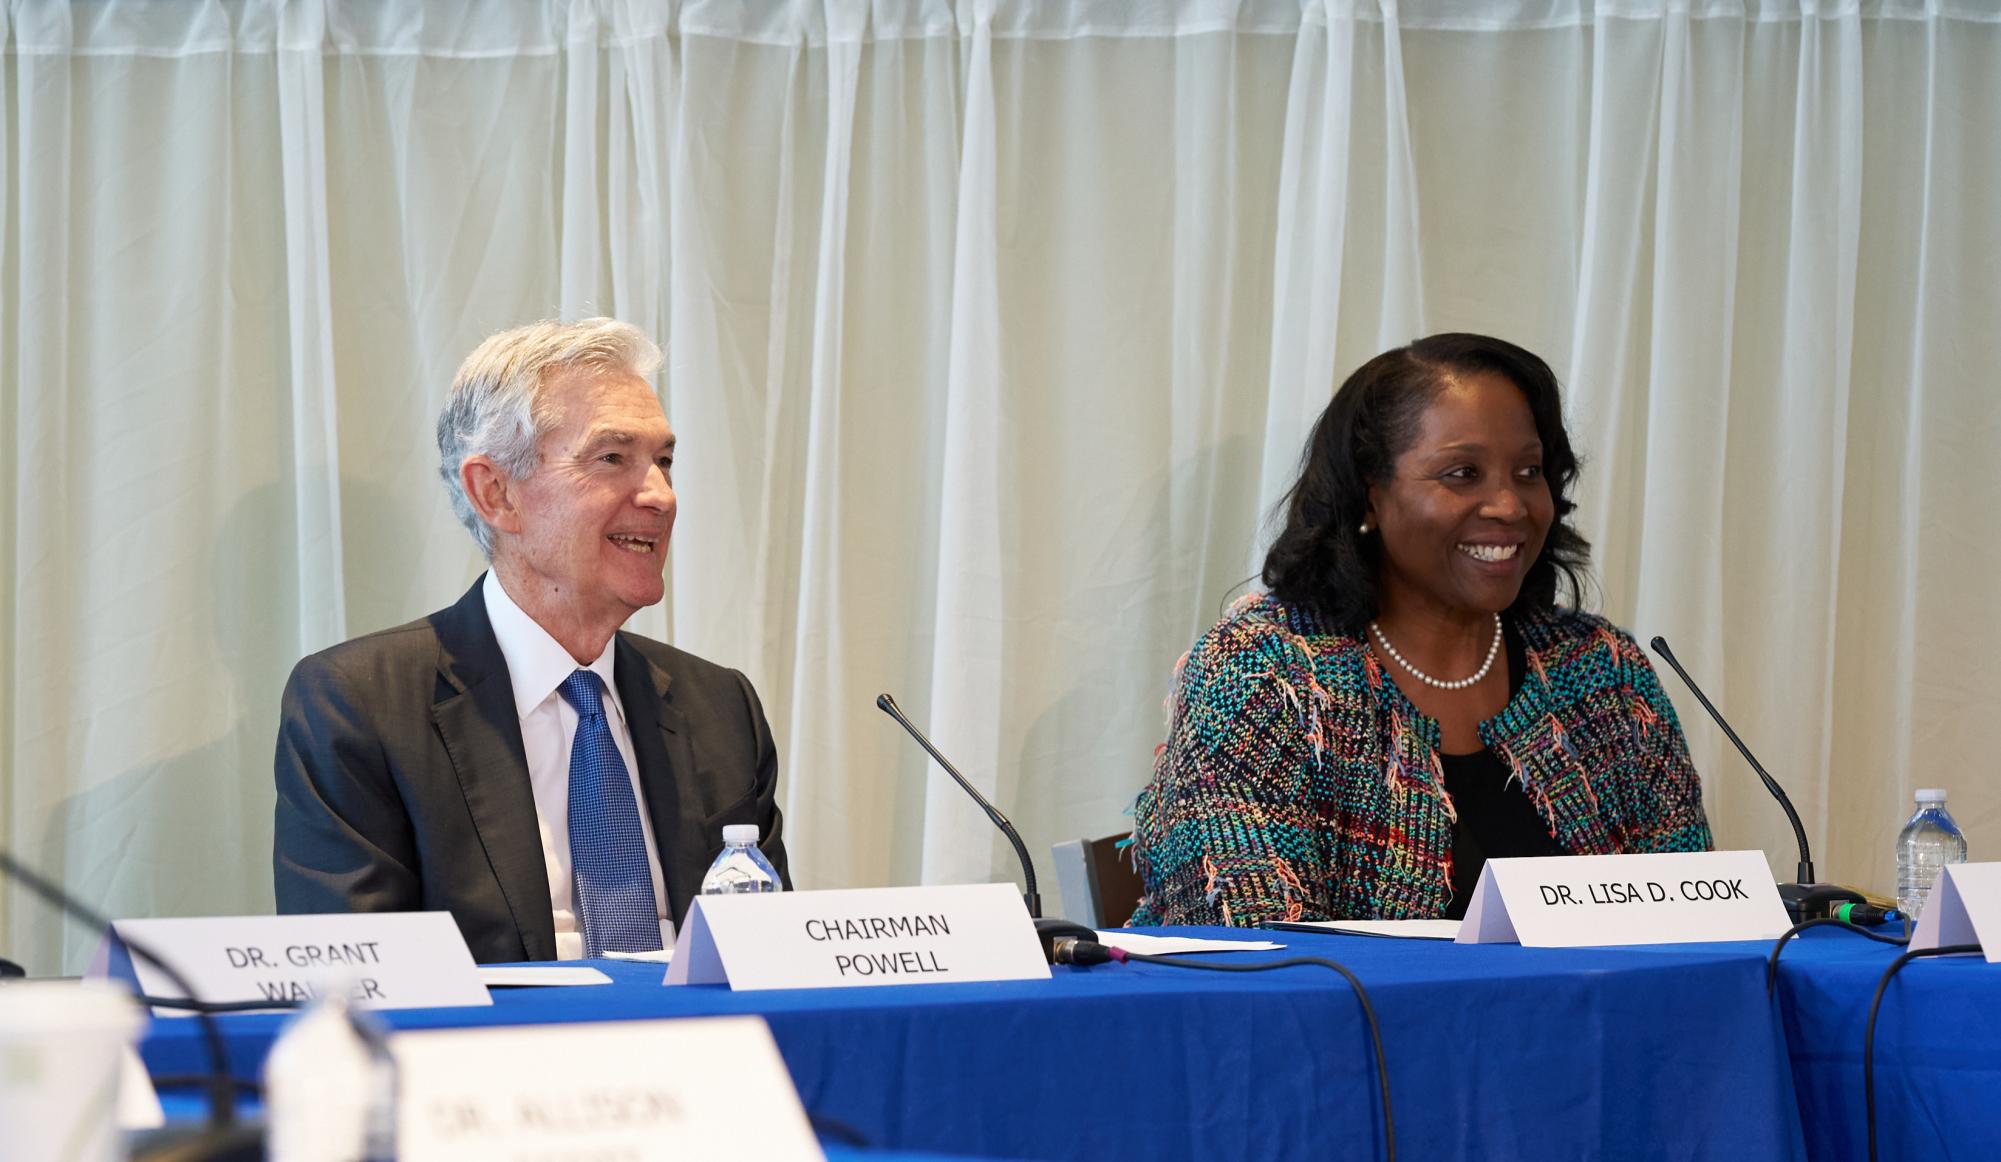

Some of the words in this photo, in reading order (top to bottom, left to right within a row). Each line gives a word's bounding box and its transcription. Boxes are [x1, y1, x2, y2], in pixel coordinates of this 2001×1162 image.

[1539, 884, 1583, 906] DR.
[1588, 882, 1644, 904] LISA
[1646, 881, 1675, 902] D.
[1680, 878, 1750, 901] COOK
[805, 913, 951, 941] CHAIRMAN
[225, 947, 278, 969] DR.
[286, 942, 381, 968] GRANT
[835, 950, 949, 976] POWELL
[256, 978, 387, 1001] WAER
